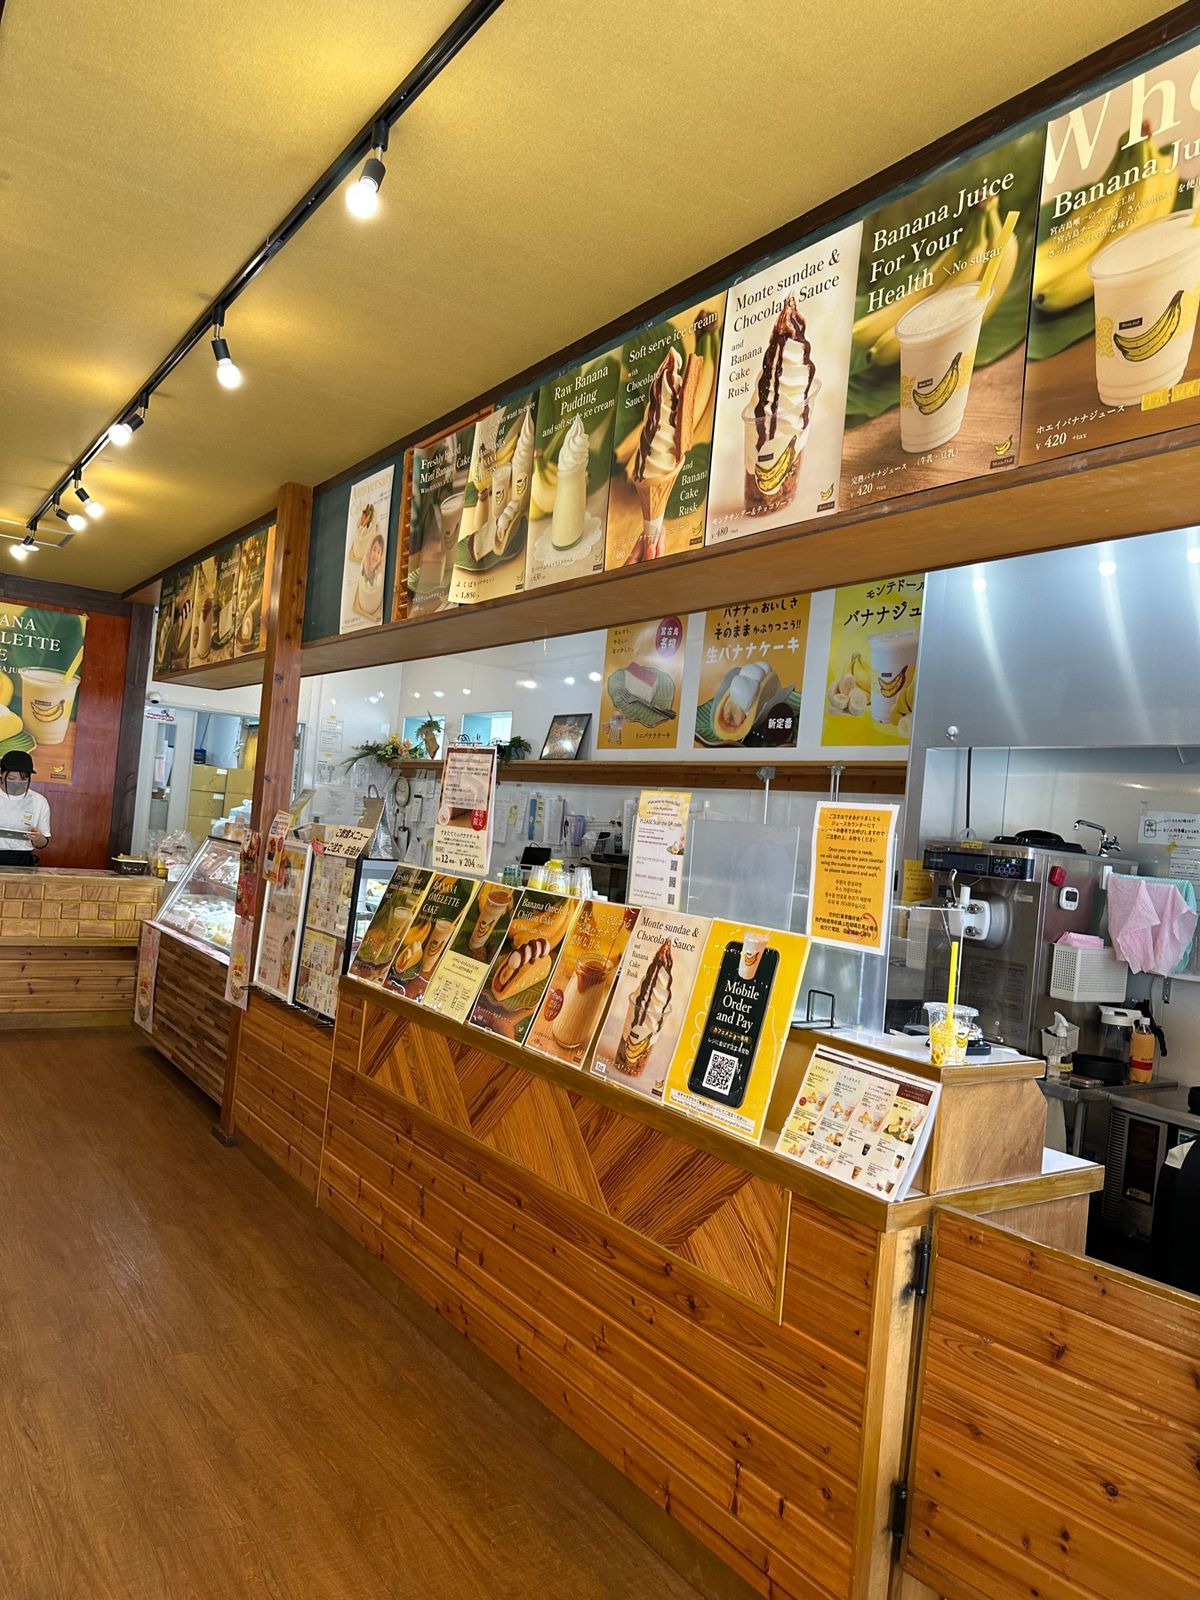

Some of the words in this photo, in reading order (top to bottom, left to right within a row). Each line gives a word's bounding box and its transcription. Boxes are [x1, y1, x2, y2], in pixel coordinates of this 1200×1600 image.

[1051, 158, 1158, 220] Banana
[872, 205, 948, 253] Banana
[953, 173, 1014, 218] Juice
[870, 255, 905, 283] For
[911, 228, 963, 263] Your
[736, 281, 773, 311] Monte
[777, 259, 824, 291] sundae
[829, 249, 841, 266] &
[867, 268, 934, 312] Health
[951, 261, 967, 274] No
[969, 247, 1002, 265] sugar
[798, 274, 840, 303] Sauce
[629, 345, 646, 363] Soft
[648, 335, 672, 353] serve
[673, 329, 685, 342] ice
[689, 312, 718, 333] cream
[731, 340, 744, 351] and
[730, 345, 763, 367] Banana
[554, 383, 573, 401] Raw
[574, 366, 609, 391] Banana
[728, 367, 750, 383] Cake
[727, 382, 750, 400] Rusk
[560, 389, 598, 416] Pudding
[625, 394, 646, 409] Sauce
[542, 424, 554, 438] and
[554, 418, 566, 432] soft
[583, 407, 593, 419] ice
[593, 398, 615, 414] cream
[1036, 404, 1125, 434] ホエイバナナジュース
[1044, 432, 1067, 448] 420
[420, 467, 436, 483] Mini
[456, 454, 471, 468] Cake
[421, 451, 445, 470] Freshly
[682, 460, 694, 472] and
[681, 470, 708, 486] Banana
[680, 488, 699, 501] Cake
[857, 483, 872, 496] 420
[678, 502, 698, 517] Rusk
[716, 526, 729, 537] 480
[724, 598, 799, 618] バナナのおいしさ
[0, 614, 36, 631] ANA
[0, 631, 61, 652] LETTE
[660, 637, 677, 649] 名物
[706, 637, 800, 664] 生バナナケーキ
[768, 717, 793, 729] 新定番
[464, 858, 475, 868] 204
[423, 903, 439, 914] CAKE
[428, 894, 461, 907] OMELETTE
[521, 898, 544, 911] Banana
[517, 910, 539, 922] Chiffon
[539, 913, 554, 926] Cake
[641, 916, 664, 931] Monte
[664, 920, 691, 937] sundae
[691, 927, 700, 938] &
[672, 936, 696, 952] Sauce
[632, 951, 649, 961] Banana
[626, 969, 639, 978] Rusk
[629, 960, 641, 970] Cake
[725, 980, 760, 1000] Mobile
[723, 995, 753, 1014] Order
[716, 1011, 735, 1024] and
[736, 1014, 754, 1033] Pay
